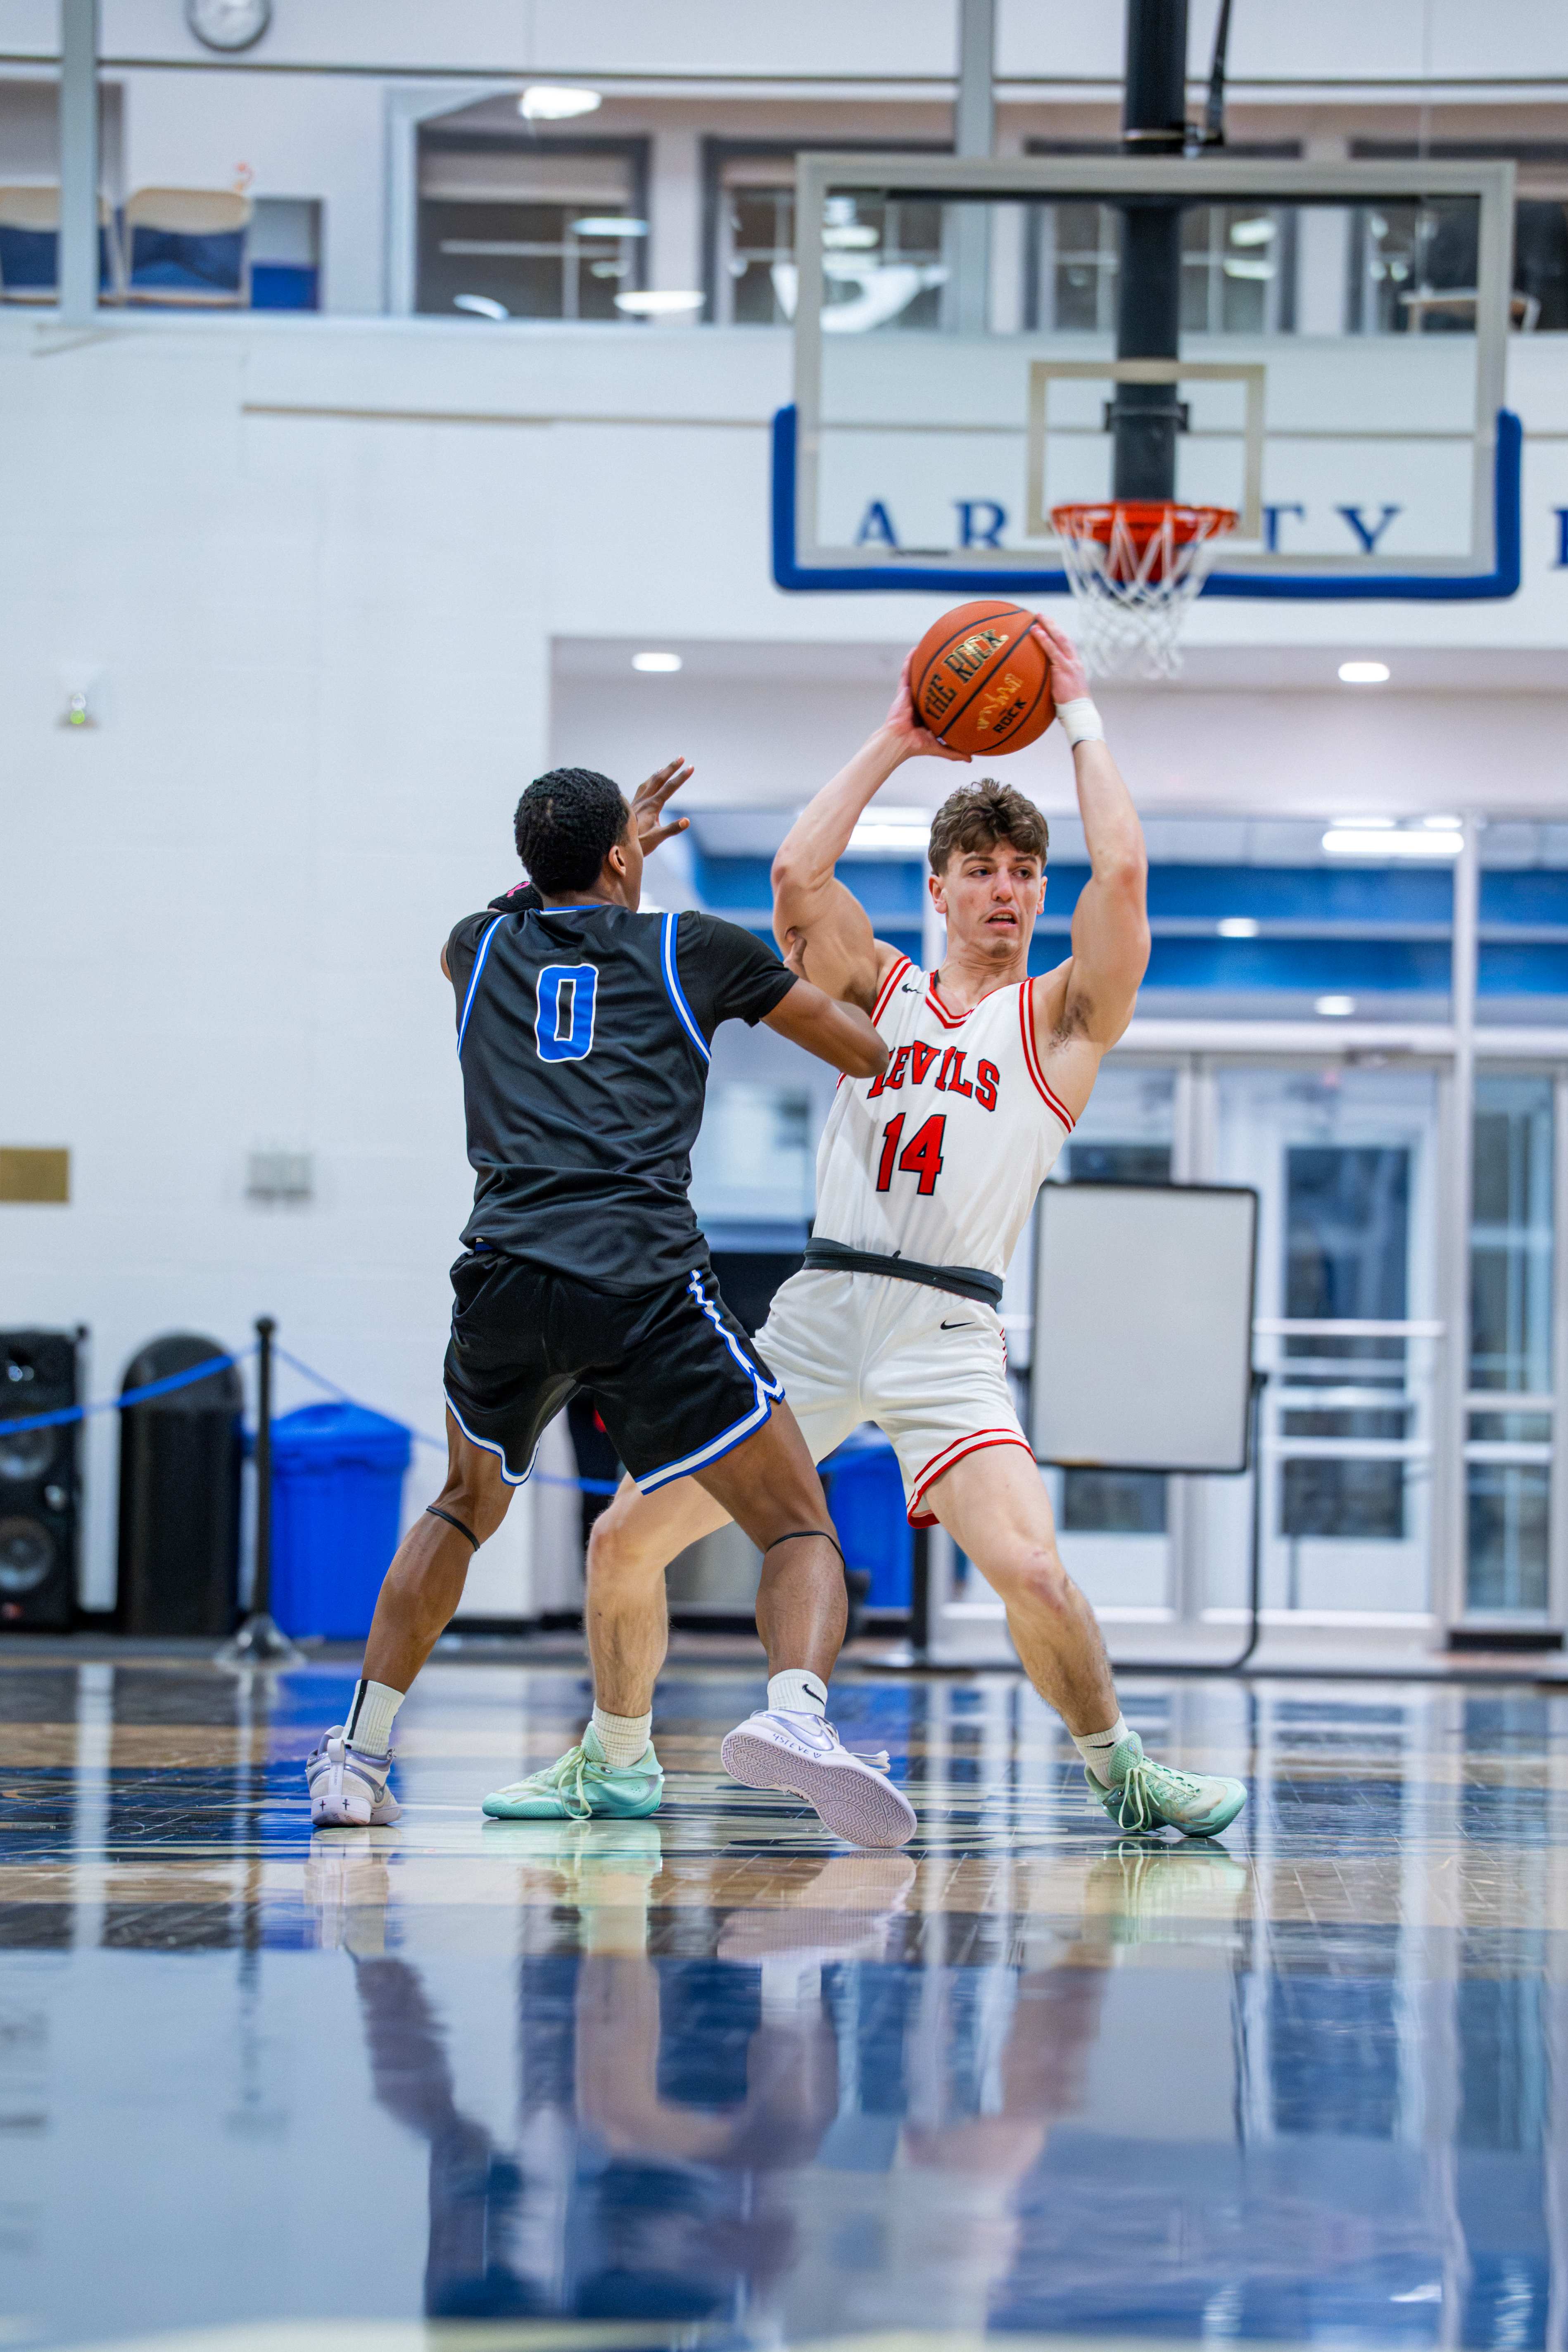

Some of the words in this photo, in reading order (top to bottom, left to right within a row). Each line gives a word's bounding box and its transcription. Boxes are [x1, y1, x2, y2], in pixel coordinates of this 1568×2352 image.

[925, 673, 957, 720] THE
[942, 629, 1009, 684] ROCK
[992, 697, 1027, 733] ROCK
[534, 963, 599, 1063] 0
[876, 1112, 947, 1196] 14
